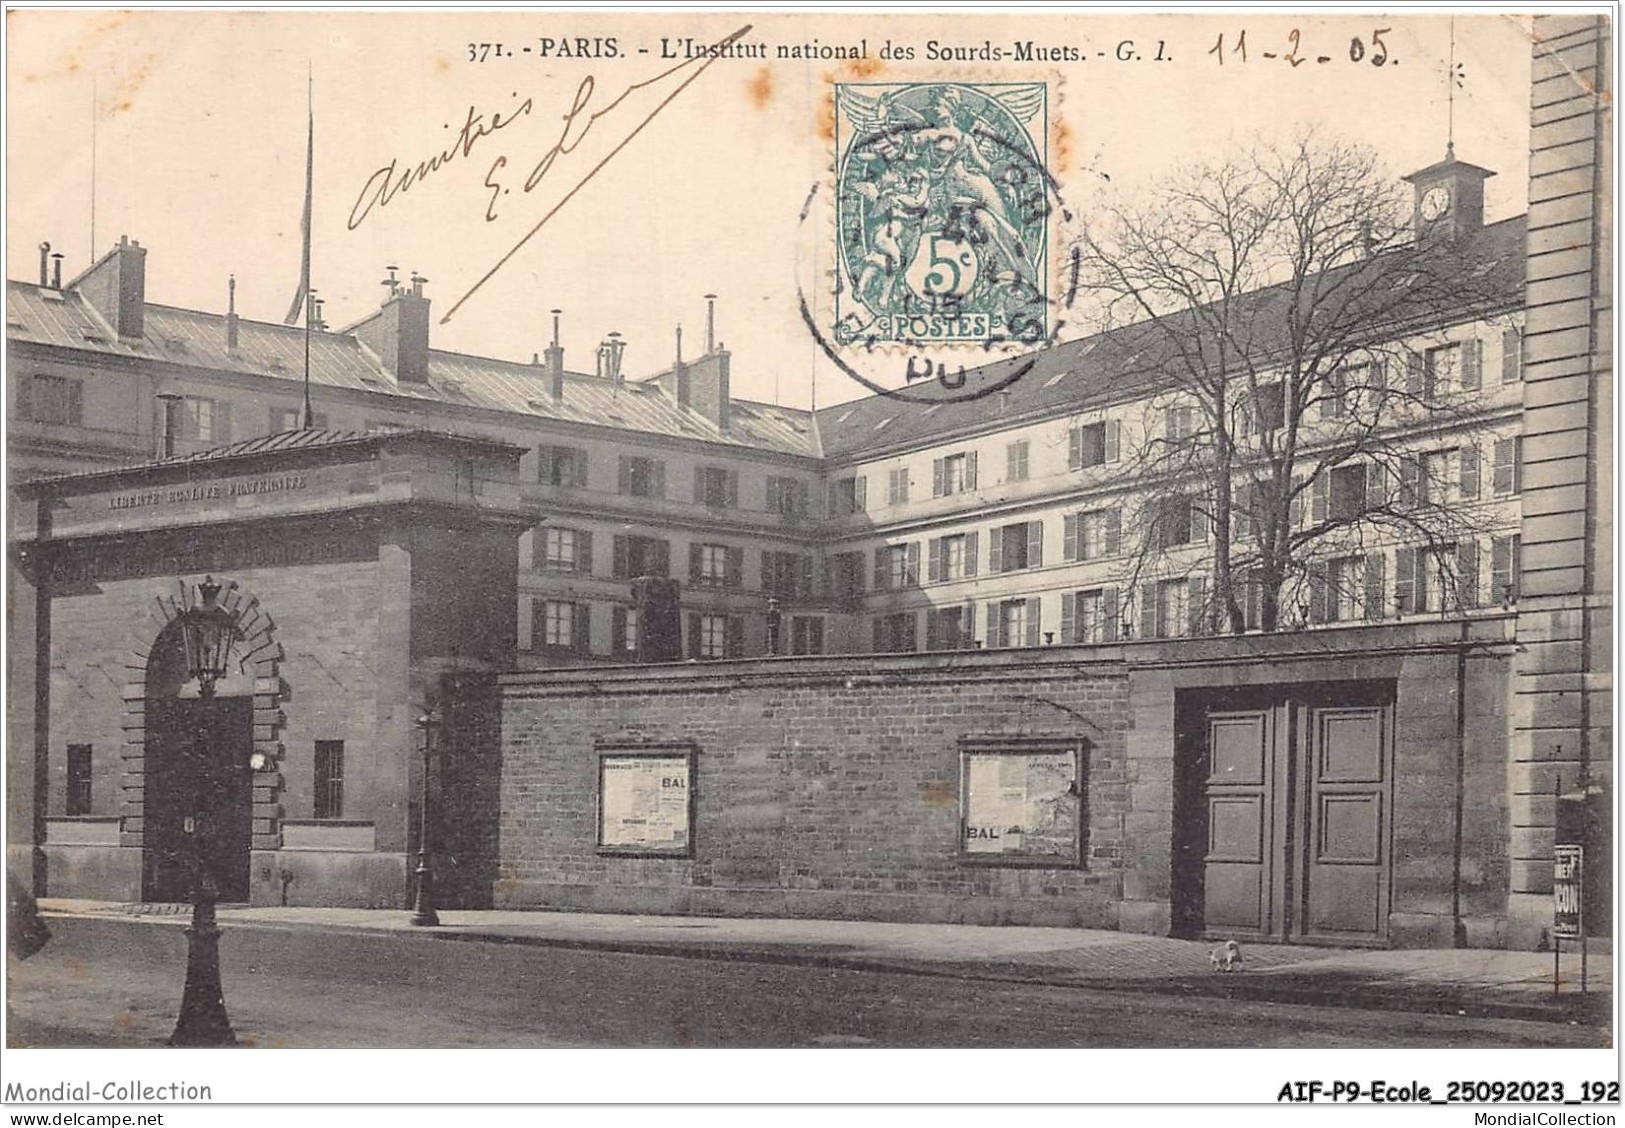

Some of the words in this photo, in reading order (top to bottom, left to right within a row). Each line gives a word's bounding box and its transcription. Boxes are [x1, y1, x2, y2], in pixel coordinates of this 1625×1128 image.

[897, 315, 986, 337] POSTES
[662, 777, 687, 789] BAL
[966, 825, 1000, 840] BAL
